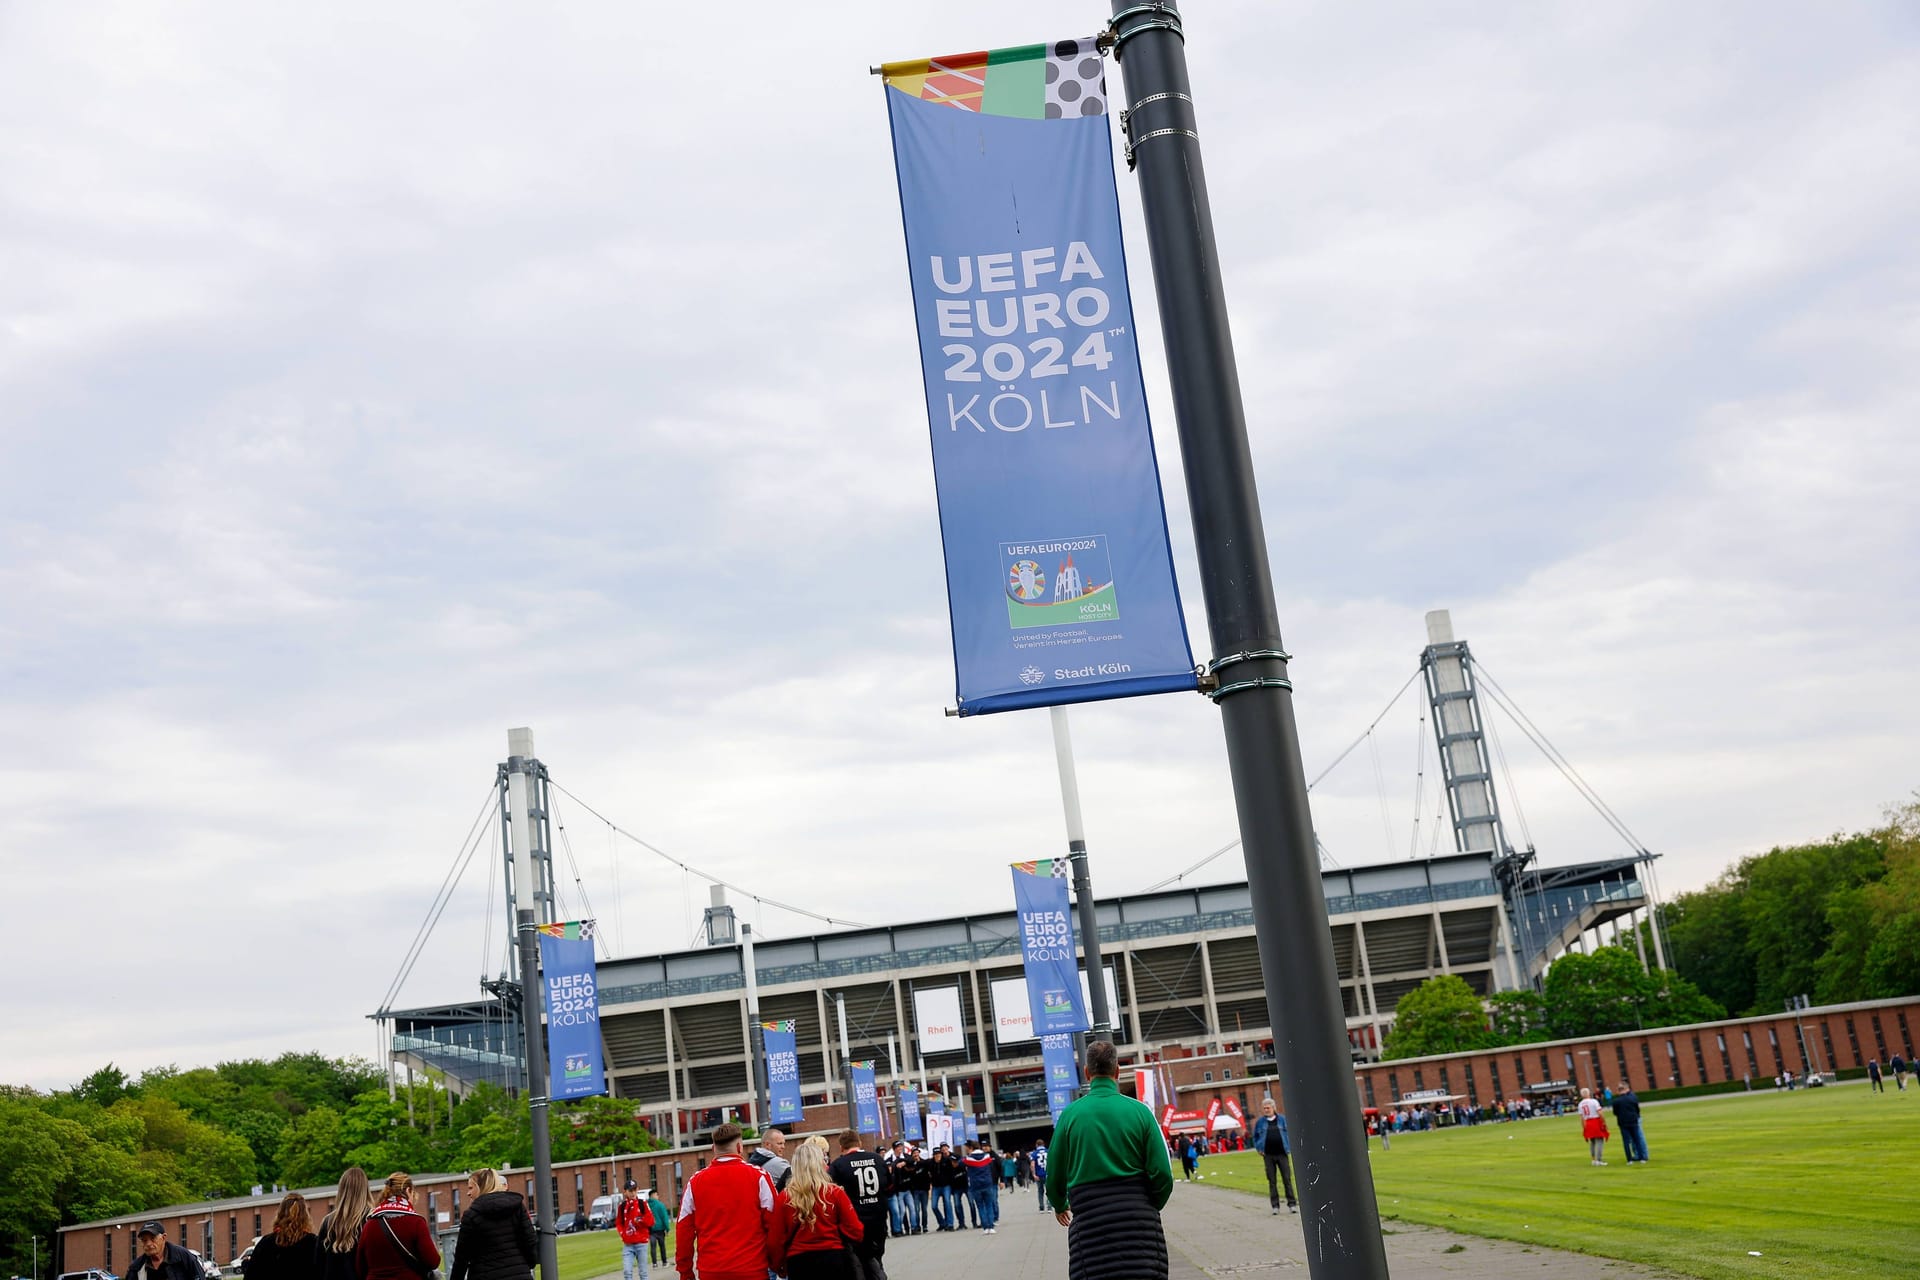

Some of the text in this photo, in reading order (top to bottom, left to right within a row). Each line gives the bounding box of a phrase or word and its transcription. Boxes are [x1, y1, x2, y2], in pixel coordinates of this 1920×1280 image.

[930, 241, 1104, 294] UEFA
[936, 287, 1109, 338] EURO
[947, 381, 1121, 433] KÖLN
[1080, 602, 1111, 614] KÖLN
[1012, 631, 1041, 642] United
[1041, 631, 1051, 640] by
[1056, 636, 1087, 645] Herzen
[1054, 663, 1131, 680] Stadt Köln
[1023, 911, 1066, 924] UEFA
[1025, 923, 1067, 936] EURO
[1027, 935, 1068, 948] 2024
[1028, 947, 1070, 962] KÖLN
[550, 973, 593, 989] UEFA
[551, 985, 594, 1001] EURO
[552, 997, 594, 1013] 2024
[553, 1010, 596, 1027] KÖLN
[928, 1025, 953, 1035] Rhein
[1043, 1033, 1069, 1042] 2024
[1043, 1040, 1070, 1050] KÖLN
[769, 1051, 795, 1060] UEFA
[770, 1058, 796, 1067] EURO
[771, 1065, 796, 1075] 2024
[853, 1166, 880, 1197] 19
